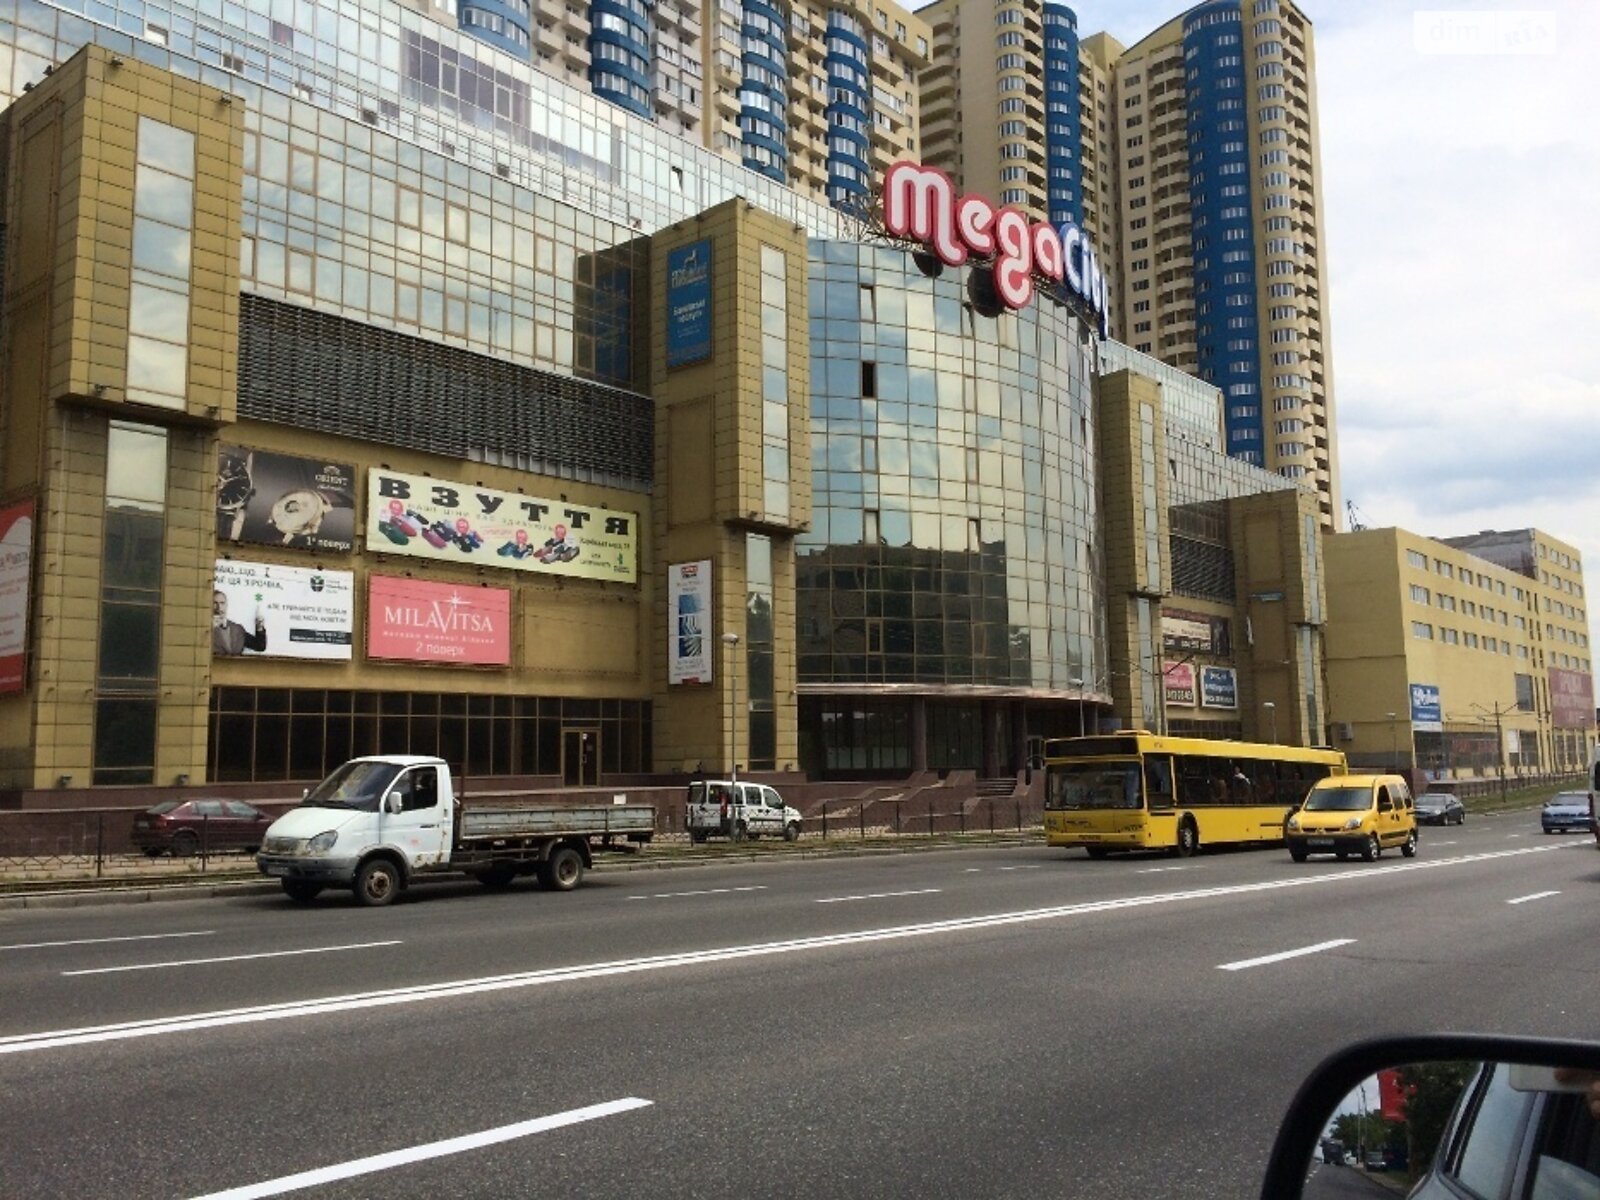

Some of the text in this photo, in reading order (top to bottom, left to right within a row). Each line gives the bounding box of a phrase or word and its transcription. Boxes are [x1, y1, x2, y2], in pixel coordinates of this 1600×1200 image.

[379, 476, 628, 536] ВЗУТТЯ
[415, 640, 466, 657] 2 поверх
